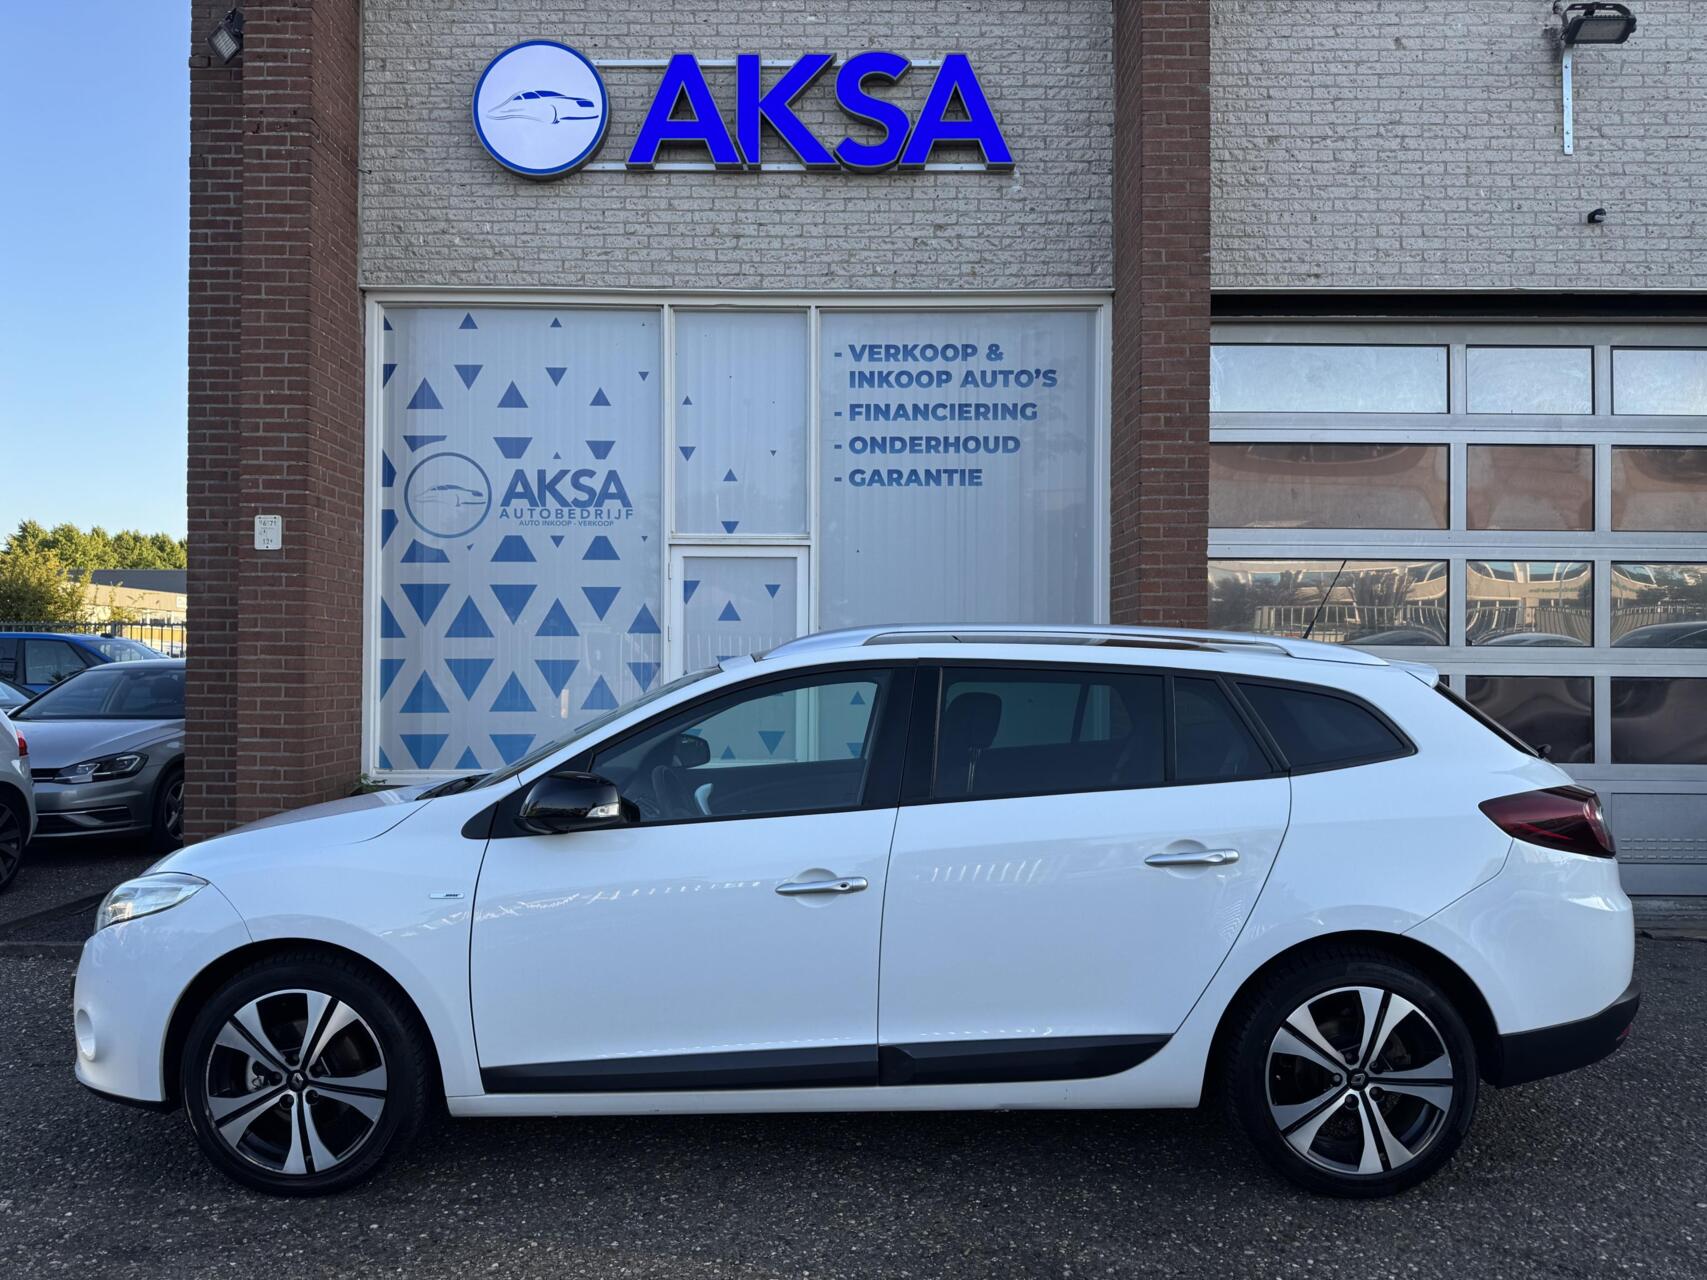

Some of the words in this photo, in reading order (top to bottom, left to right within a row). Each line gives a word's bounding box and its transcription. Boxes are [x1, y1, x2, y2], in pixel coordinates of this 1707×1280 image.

[625, 51, 1014, 171] AKSA
[848, 344, 978, 362] VERKOOP
[985, 343, 1004, 362] &
[849, 370, 953, 388] INKOOP
[849, 402, 1038, 421] FINANCIERING
[848, 435, 1021, 454] ONDERHOUD
[848, 468, 983, 487] GARANTIE
[500, 468, 633, 508] AKSA
[499, 508, 633, 520] AUTOBEDRIJF
